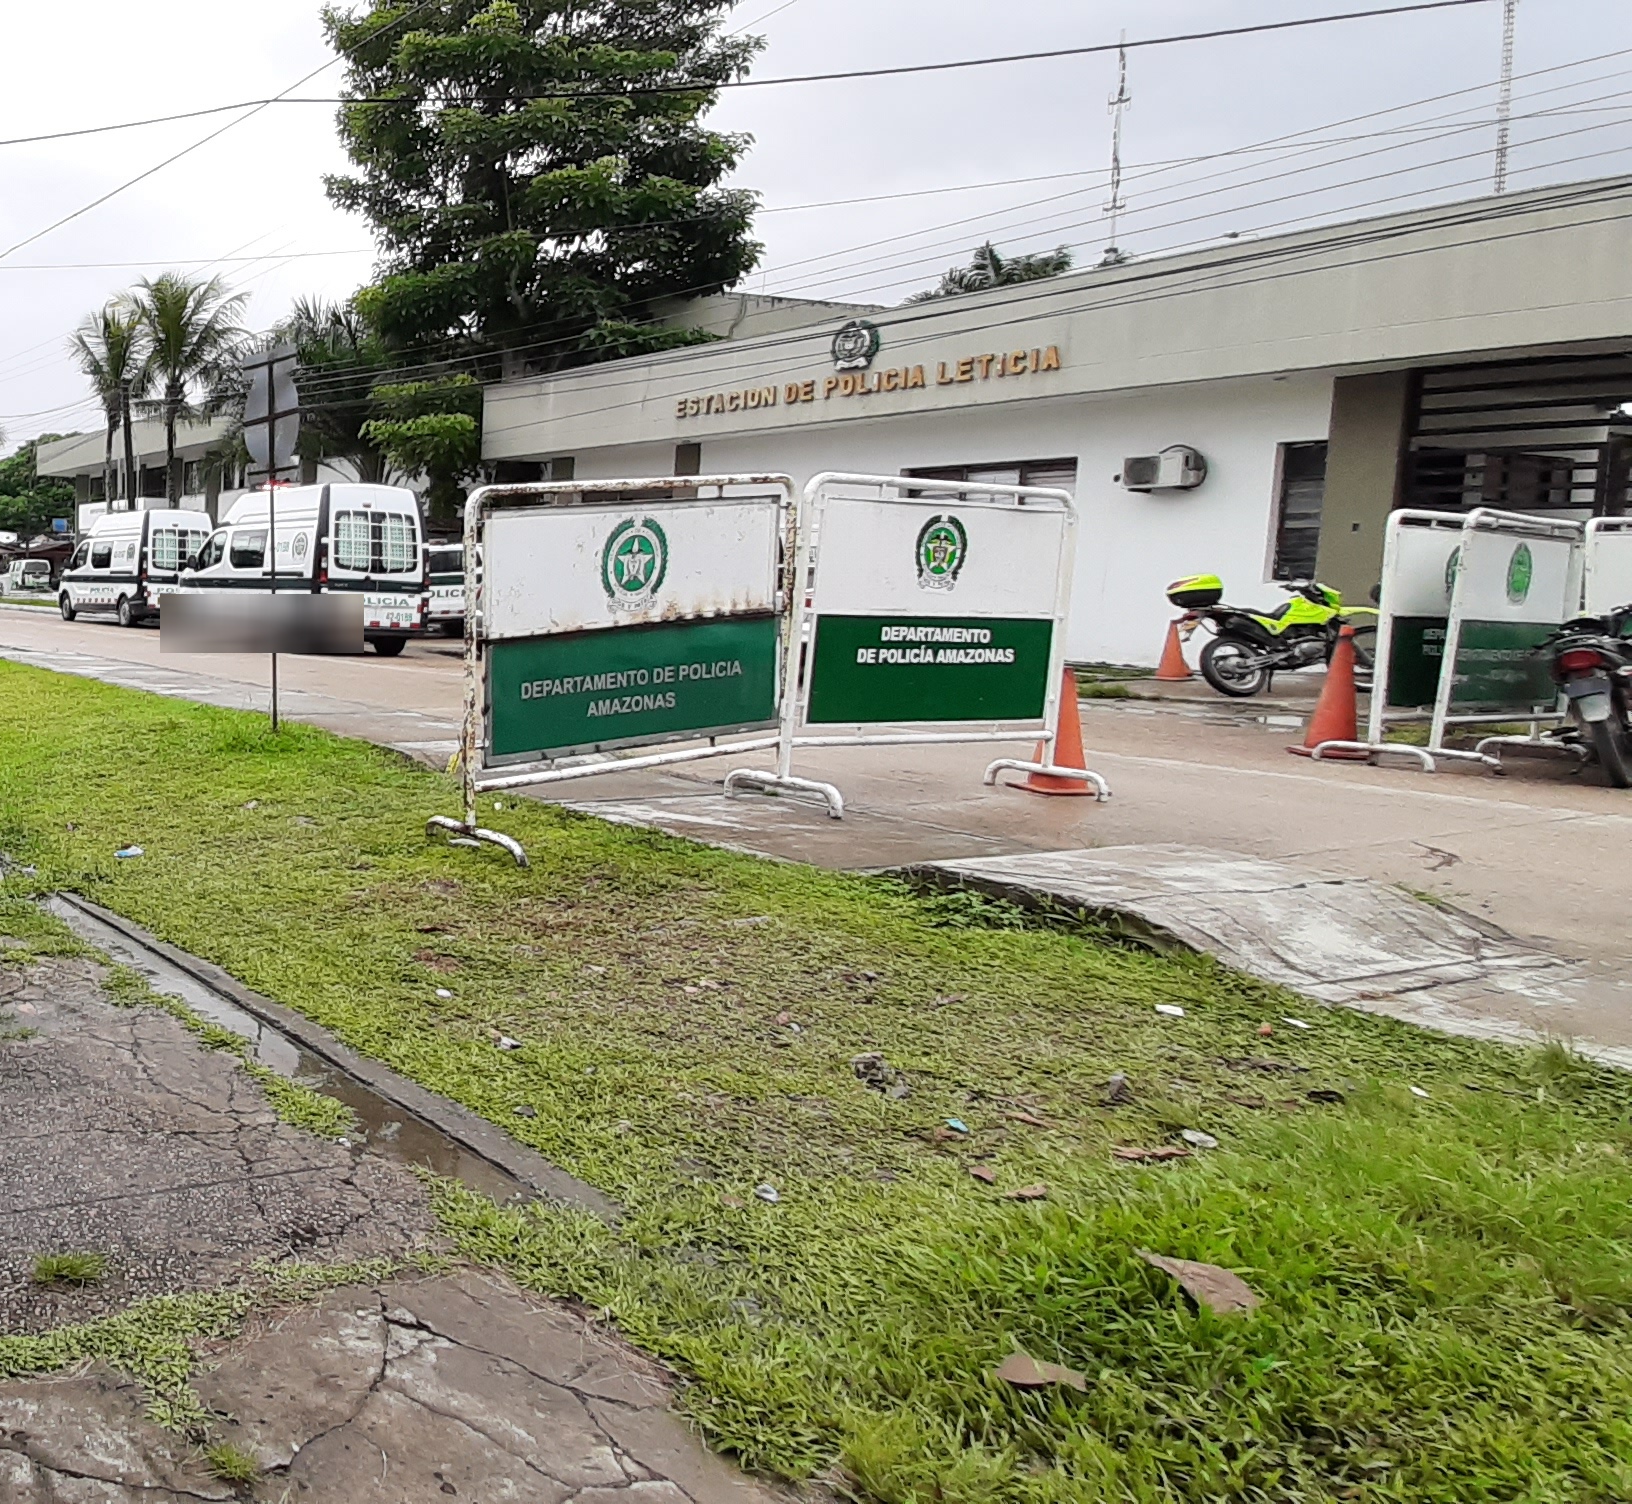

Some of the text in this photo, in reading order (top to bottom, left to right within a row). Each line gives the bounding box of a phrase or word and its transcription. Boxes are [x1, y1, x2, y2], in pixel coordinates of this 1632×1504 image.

[675, 345, 1060, 418] ESTACION DE POLICIA LETICIA
[881, 626, 991, 643] DEPARTAMENTO
[857, 644, 1015, 663] DE POLICÍA AMAZONAS
[520, 660, 742, 699] DEPARTAMENTO DE POLICIA
[586, 692, 676, 717] AMAZONAS
